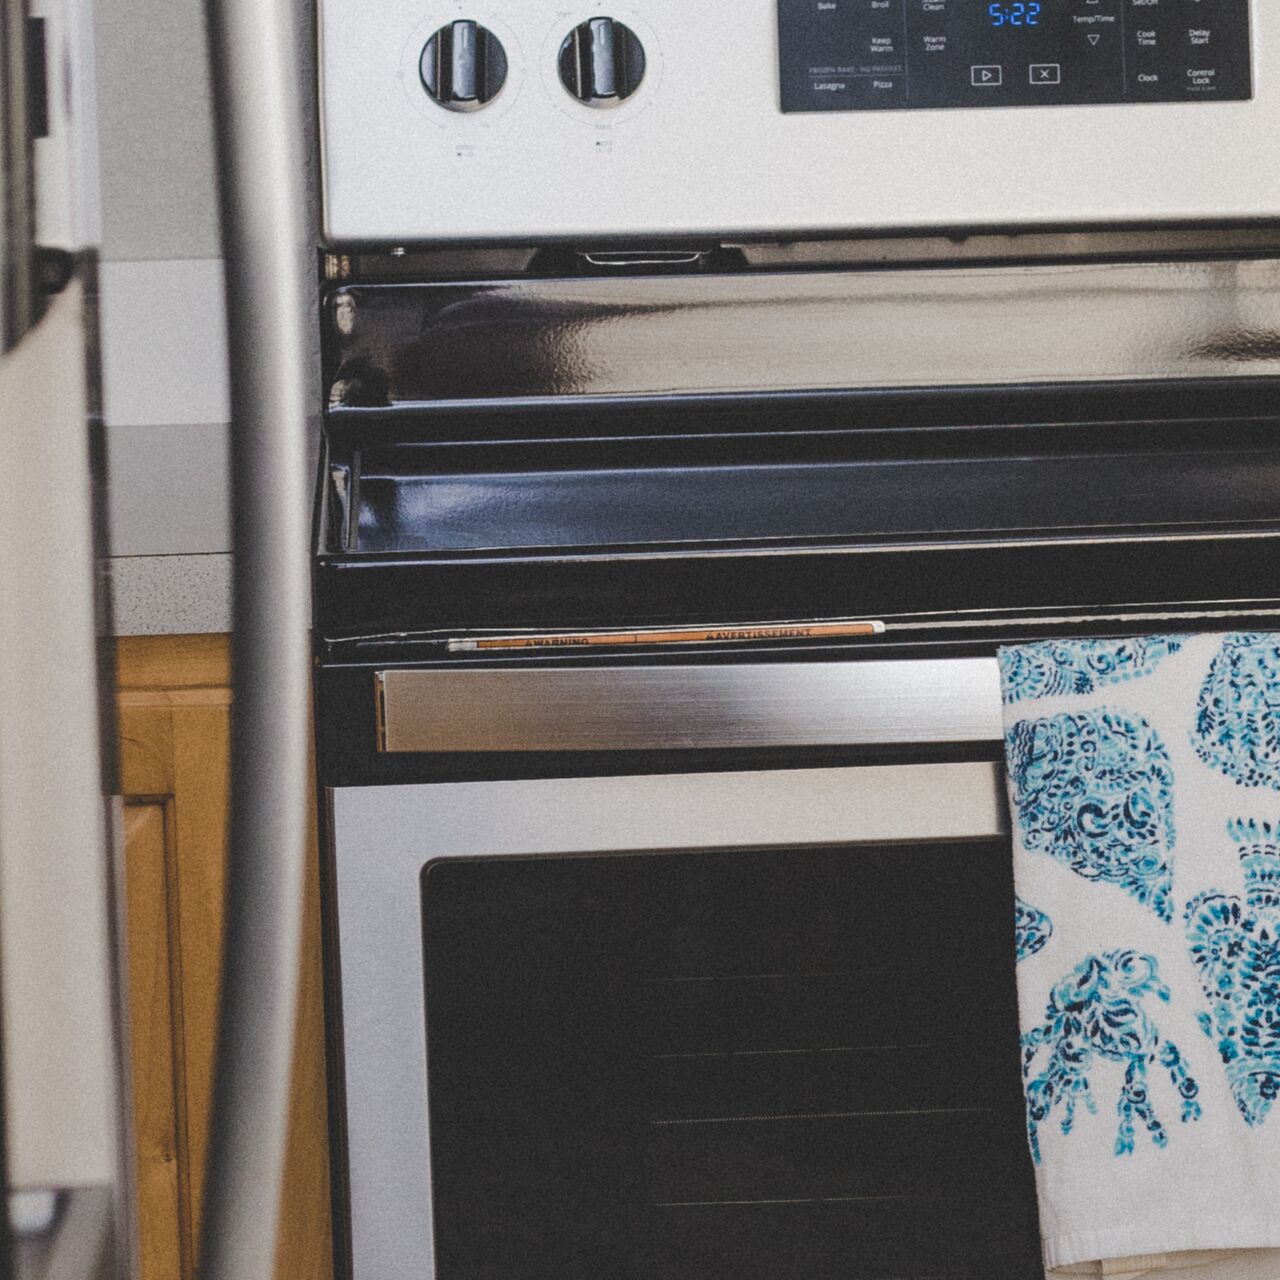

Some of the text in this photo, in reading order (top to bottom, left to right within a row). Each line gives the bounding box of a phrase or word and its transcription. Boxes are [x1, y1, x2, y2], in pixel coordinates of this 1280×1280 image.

[817, 2, 837, 10] Bake
[871, 0, 889, 8] Broil
[922, 3, 945, 11] Clean
[988, 2, 1041, 26] 5:22
[1072, 15, 1115, 24] Temp/Time
[1189, 29, 1210, 38] Delay
[871, 37, 891, 46] Keep
[925, 43, 945, 51] Zone
[1187, 69, 1215, 77] Control
[1137, 74, 1158, 82] Clock
[814, 82, 845, 91] Lasagna
[873, 80, 893, 88] Pizza
[715, 628, 812, 640] AVERTISSEMENT
[531, 638, 590, 646] WARNING
